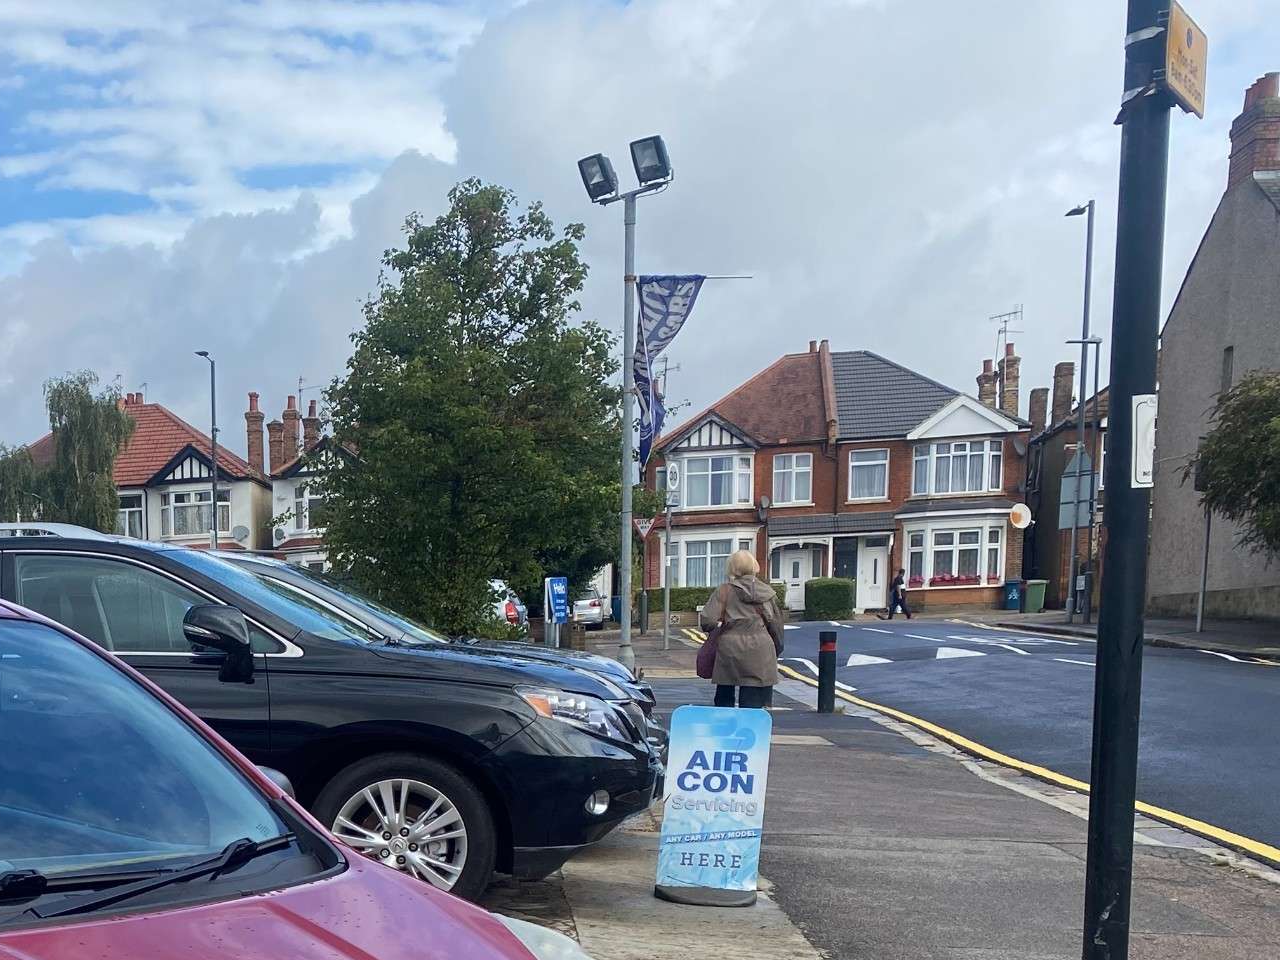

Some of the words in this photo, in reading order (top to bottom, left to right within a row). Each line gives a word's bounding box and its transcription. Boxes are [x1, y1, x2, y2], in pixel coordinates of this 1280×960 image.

[686, 750, 749, 772] AIR
[676, 771, 755, 795] CON
[671, 795, 758, 817] Servicing
[684, 834, 701, 842] CAR
[709, 831, 726, 840] ANY
[727, 830, 758, 839] MODEL
[680, 852, 742, 869] HERE
